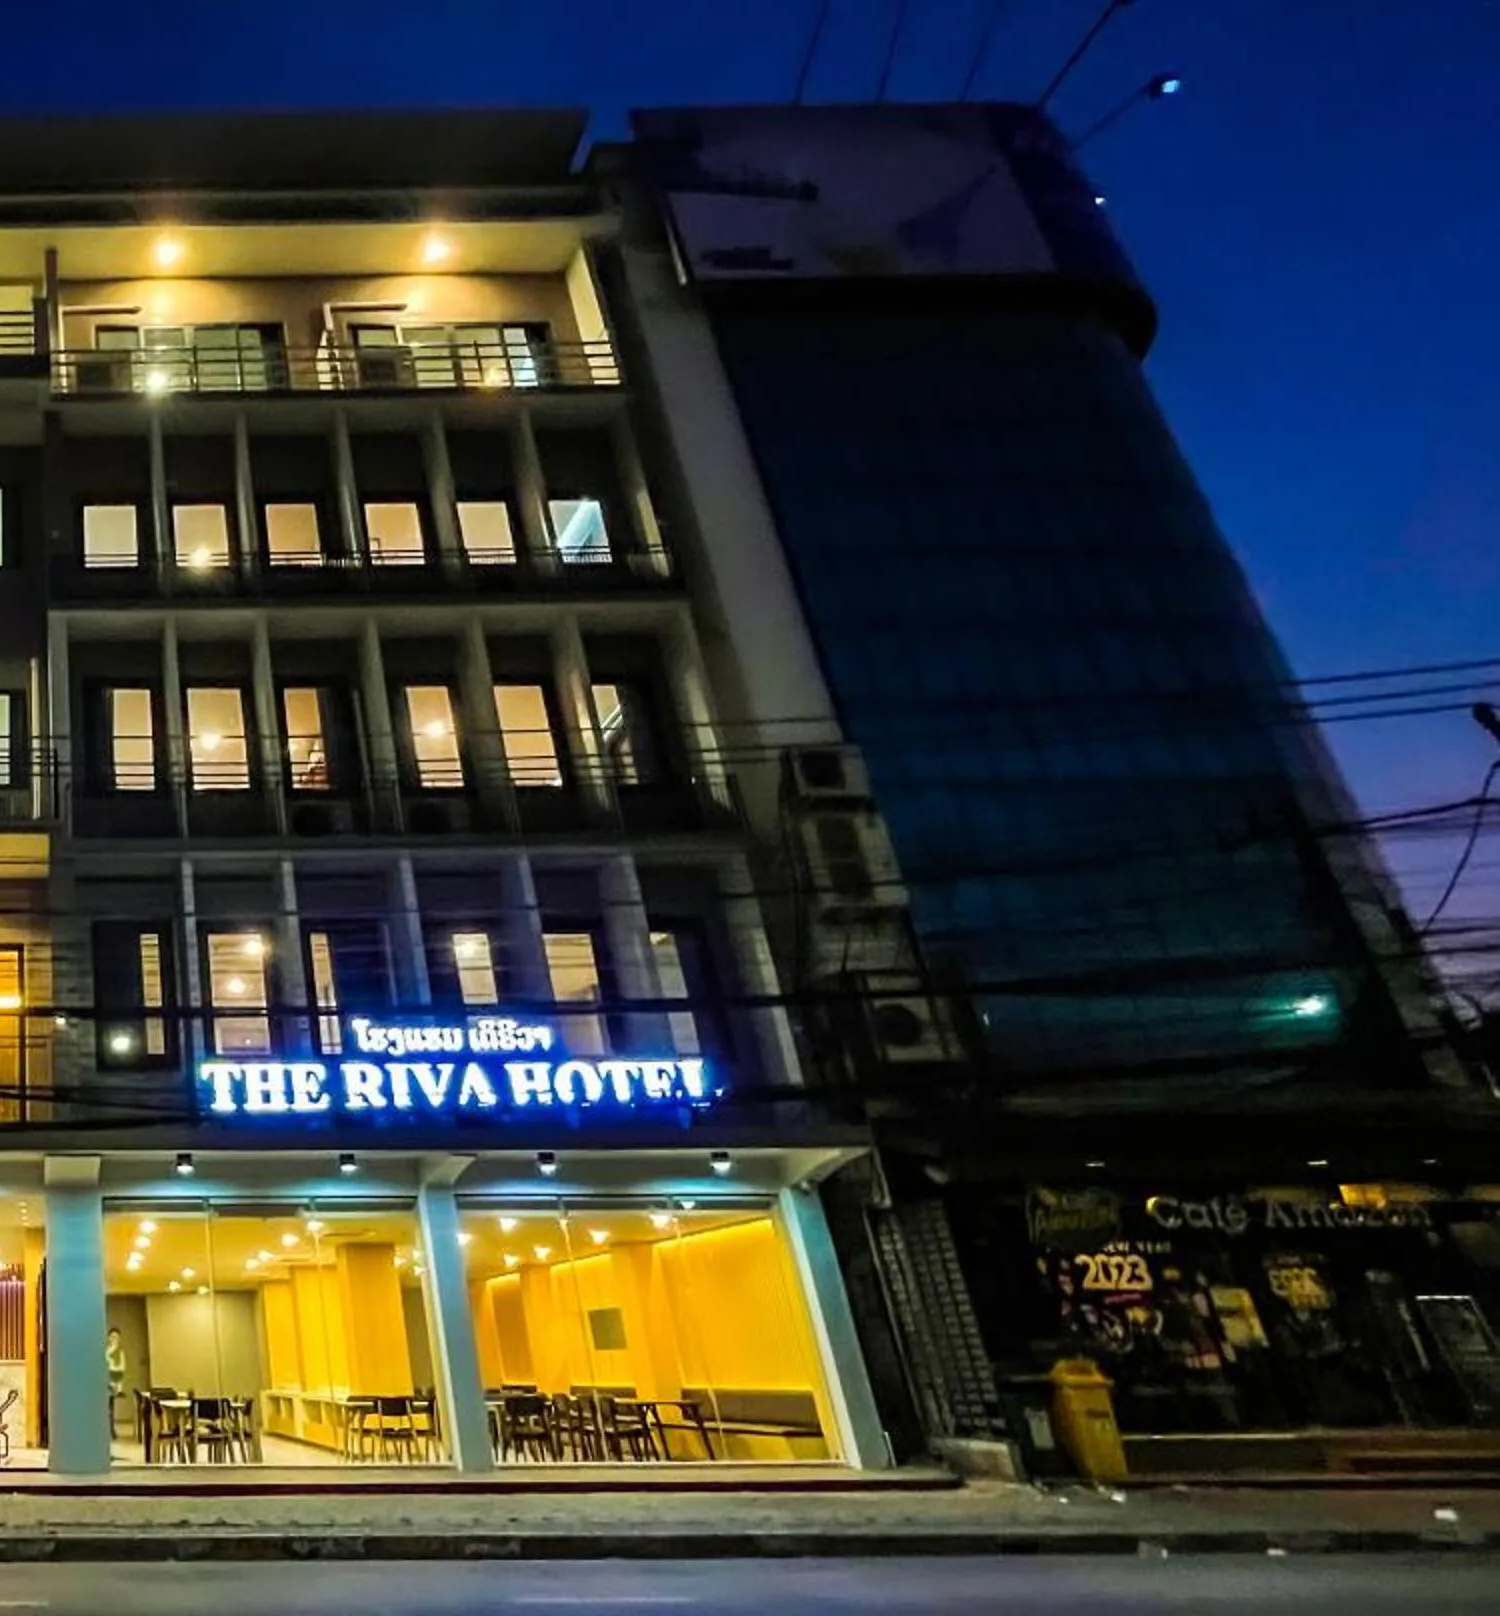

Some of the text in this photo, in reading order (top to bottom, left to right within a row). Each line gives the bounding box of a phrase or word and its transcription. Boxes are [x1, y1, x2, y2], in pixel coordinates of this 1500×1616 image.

[201, 1058, 722, 1113] THE RIVA HOTEL
[1074, 1253, 1153, 1290] 2023
